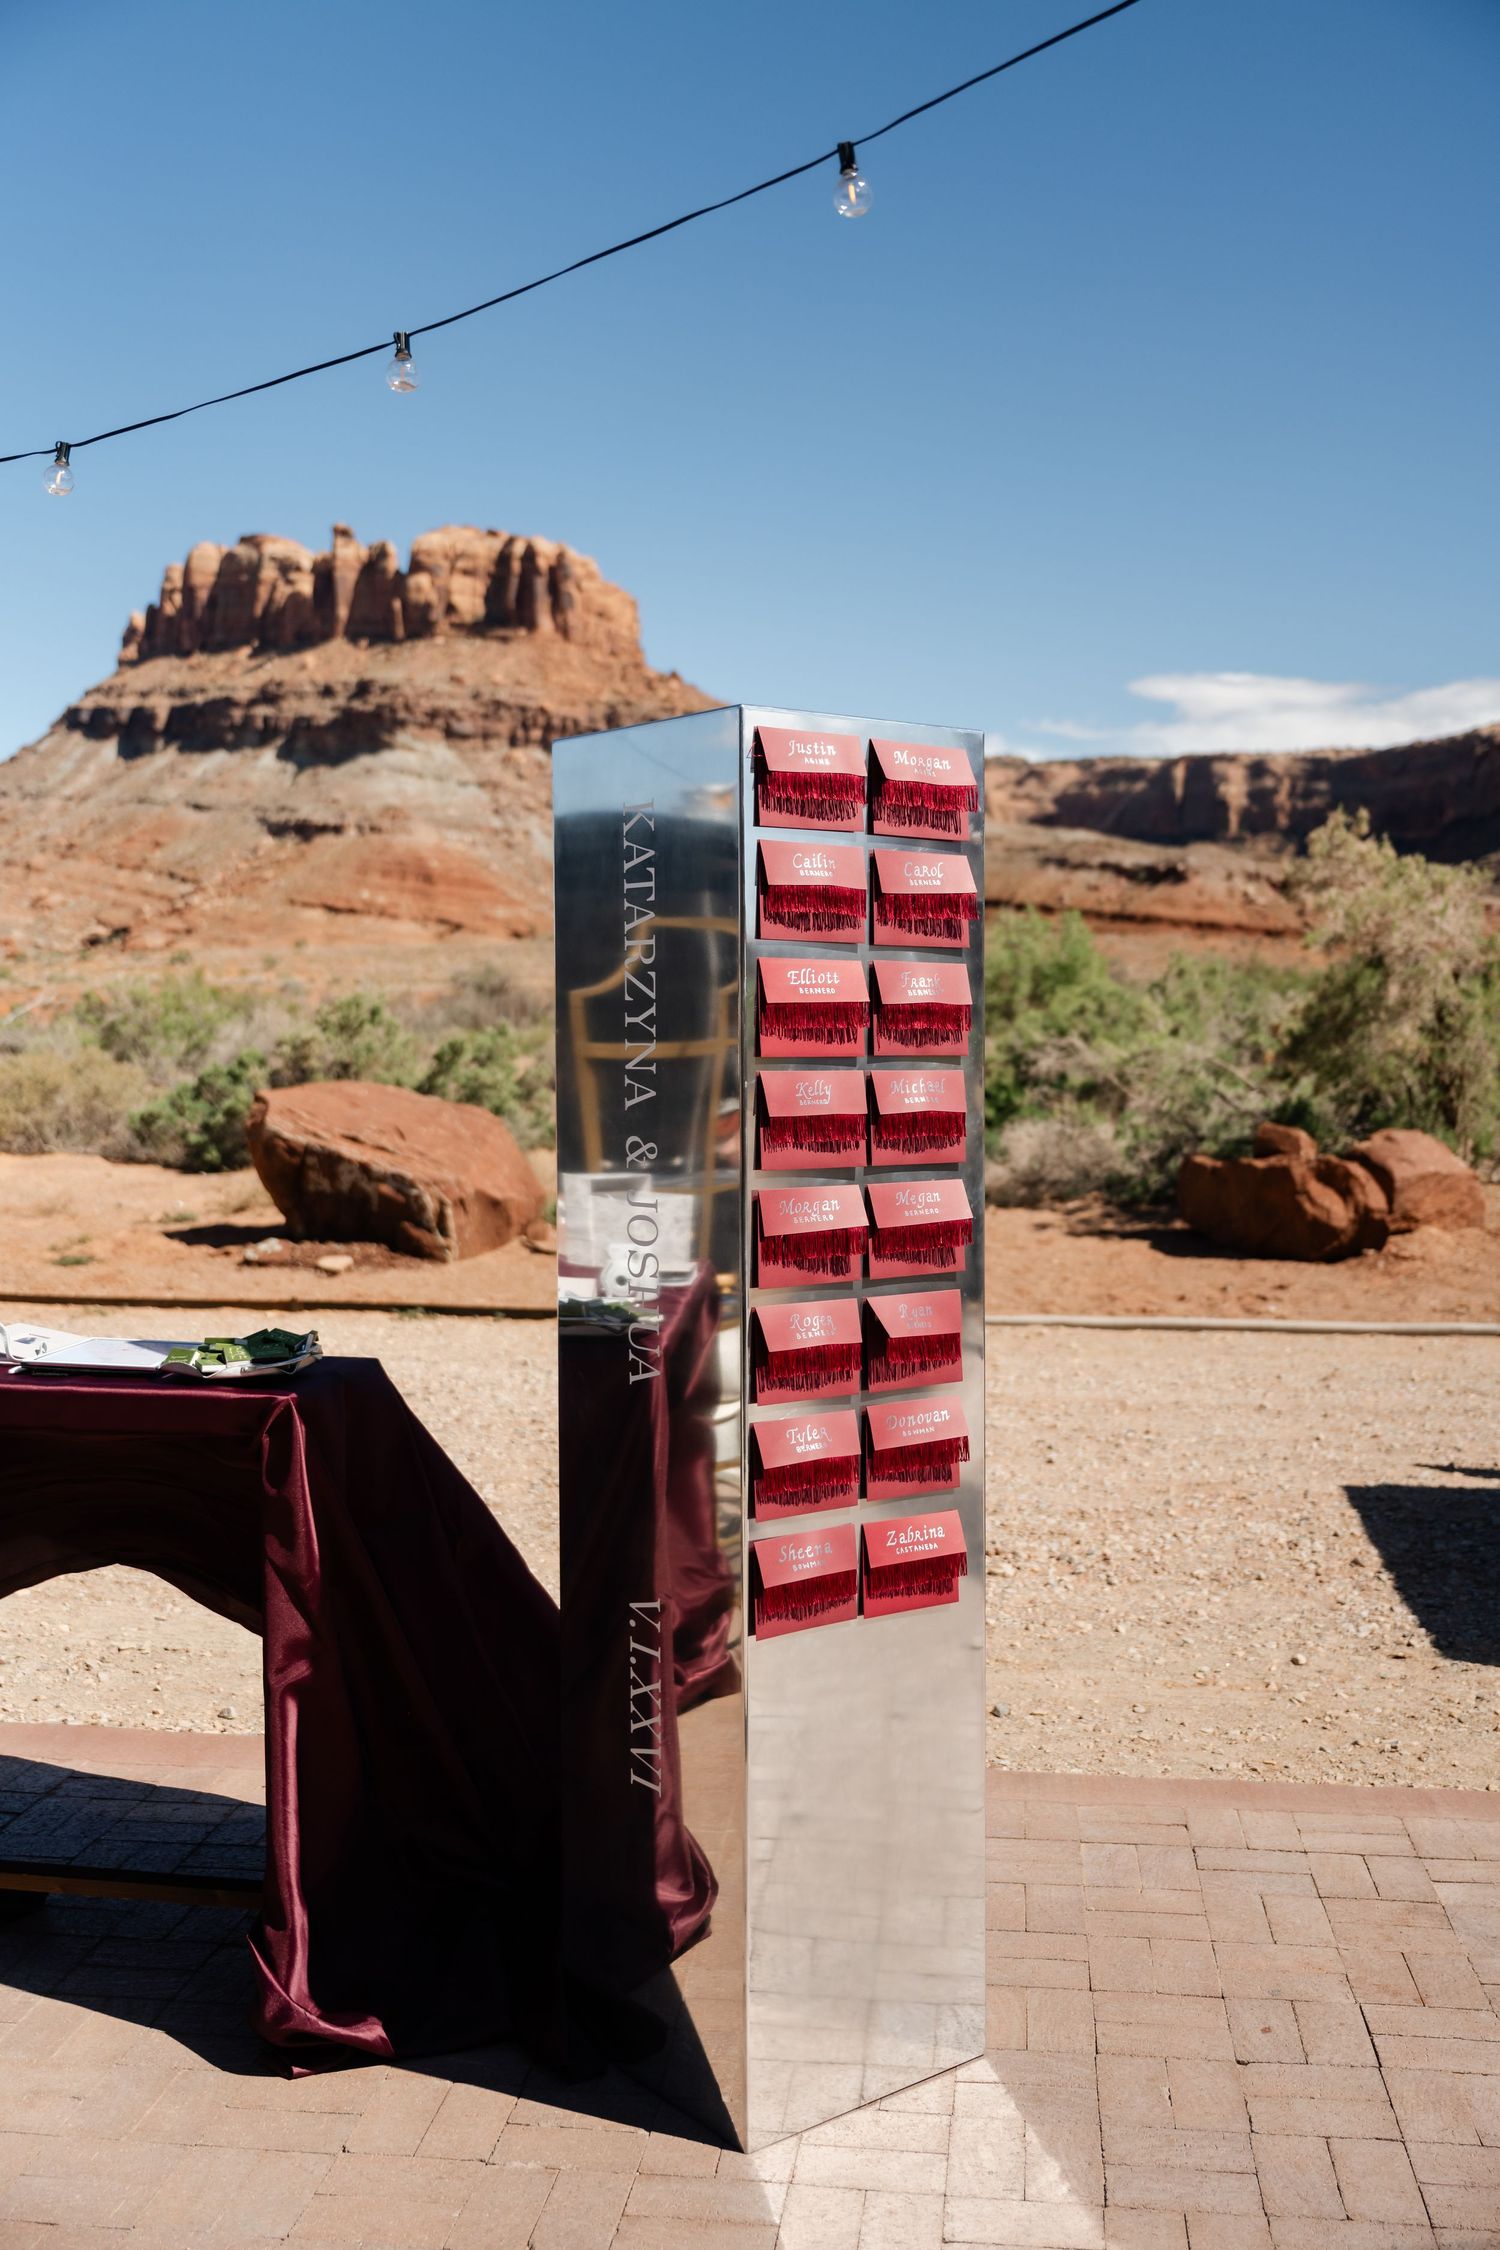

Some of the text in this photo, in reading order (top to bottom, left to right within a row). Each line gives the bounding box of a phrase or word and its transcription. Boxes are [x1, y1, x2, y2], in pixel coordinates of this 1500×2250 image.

[788, 739, 837, 756] Justin
[793, 852, 836, 869] Cailin
[787, 968, 840, 985] Elliott
[623, 798, 661, 1385] KATARZYNA & JOSHUA
[795, 1079, 832, 1104] Kelly
[890, 1078, 947, 1094] Michael
[896, 1189, 941, 1208] Megan
[886, 1409, 951, 1430] Donovan
[779, 1542, 832, 1563] Sheena
